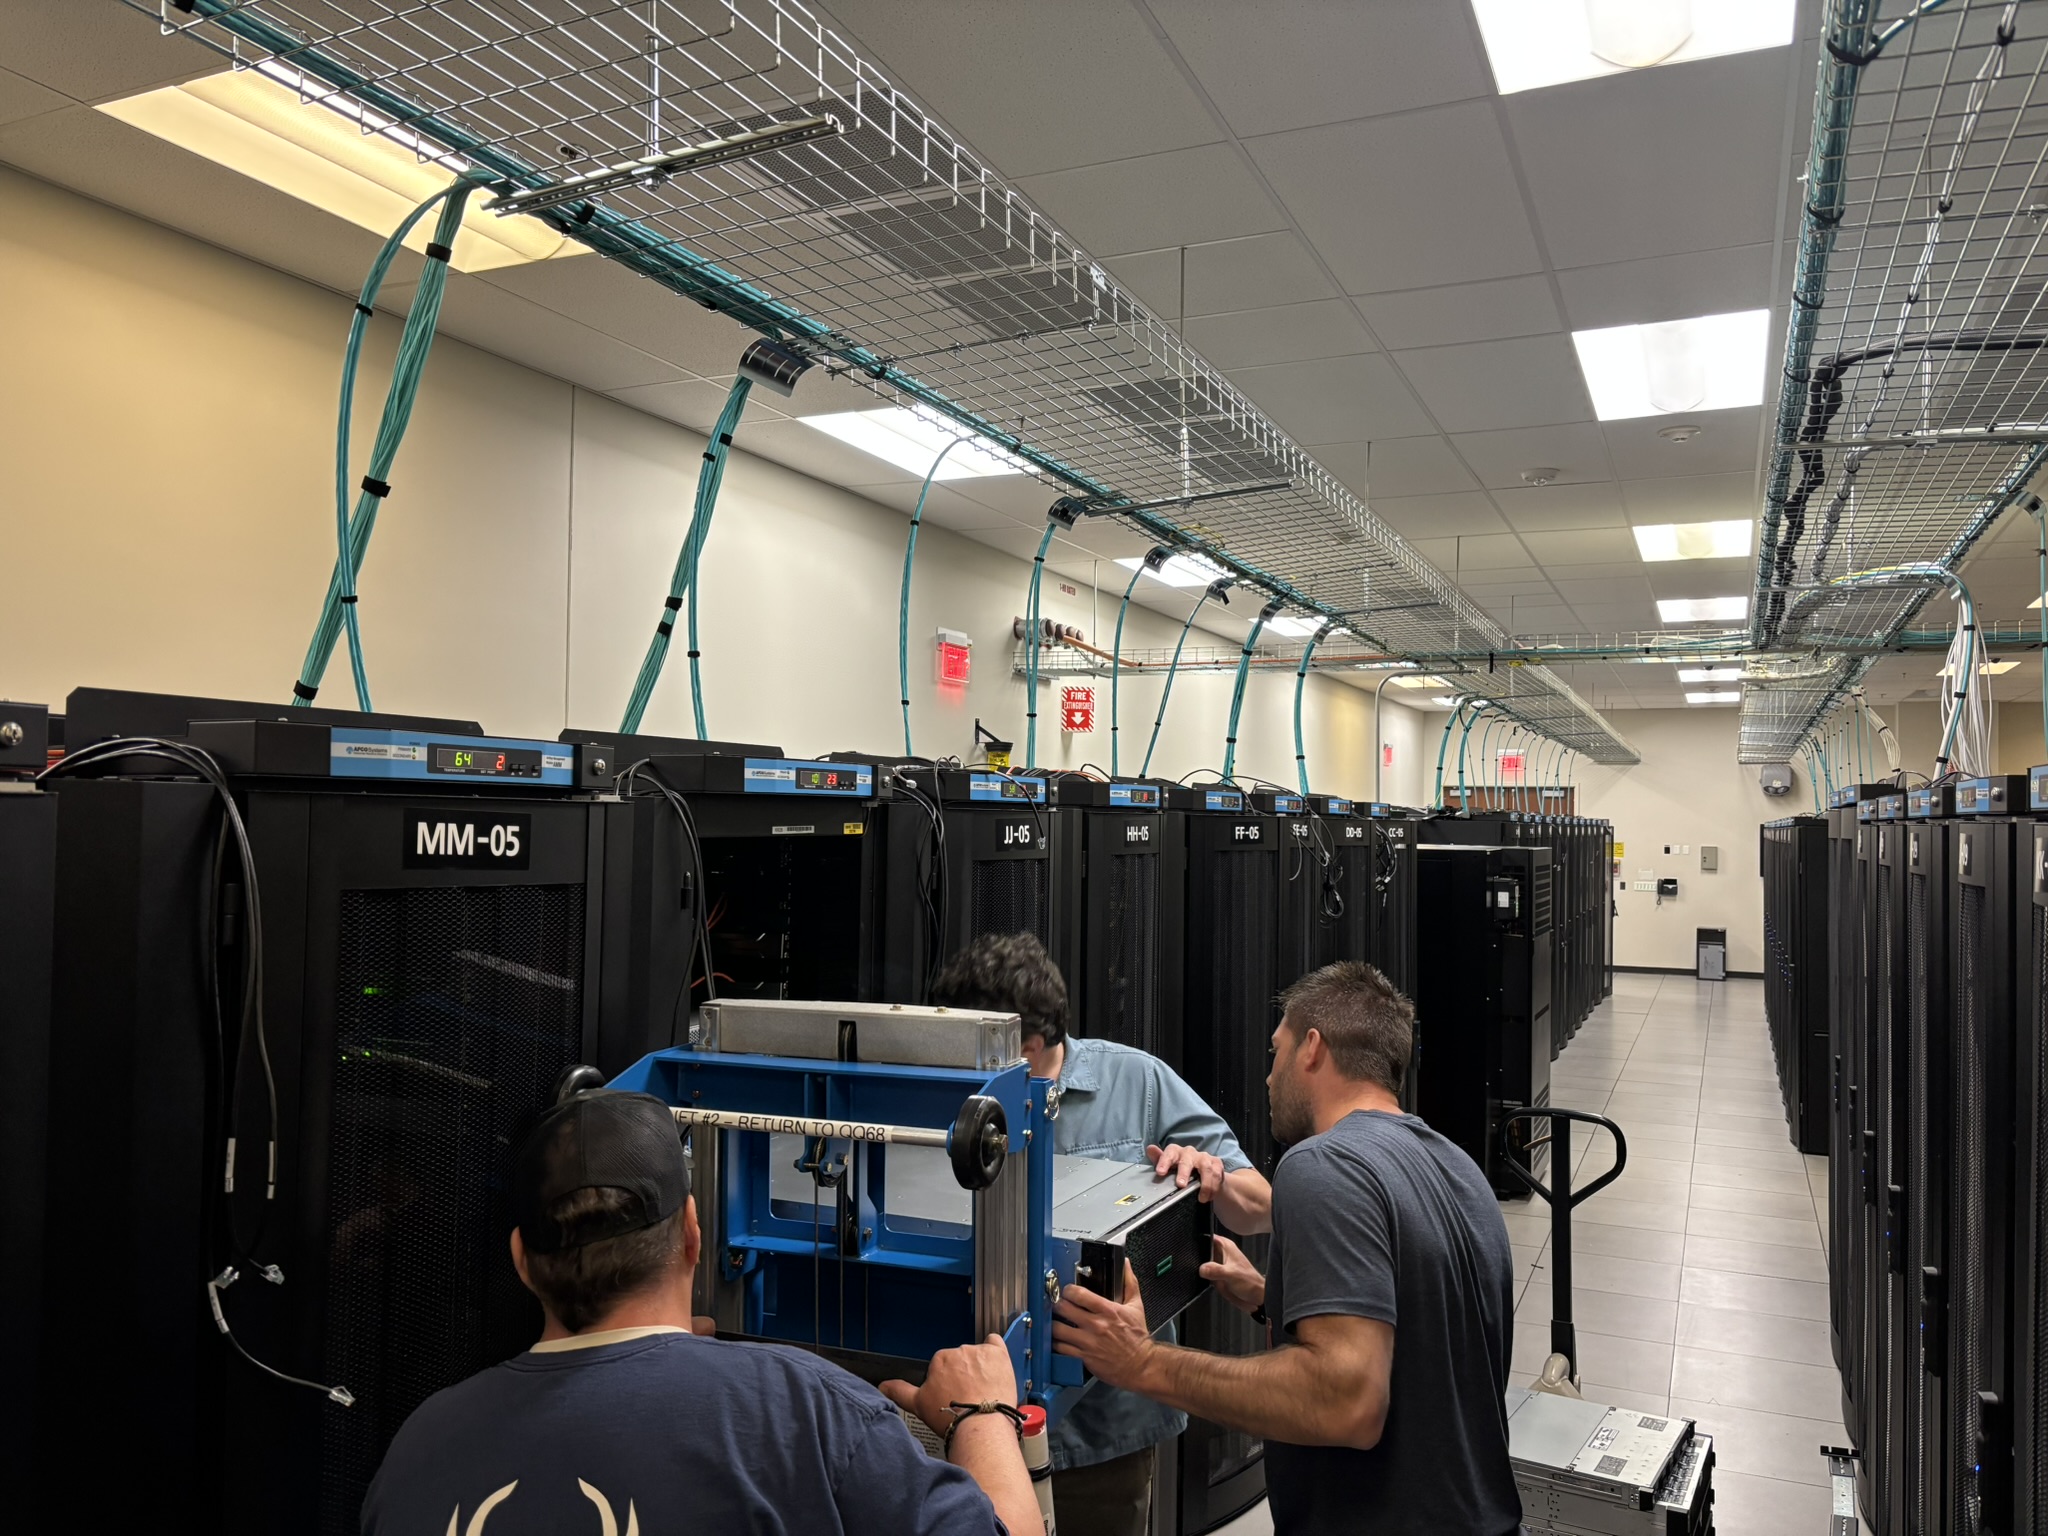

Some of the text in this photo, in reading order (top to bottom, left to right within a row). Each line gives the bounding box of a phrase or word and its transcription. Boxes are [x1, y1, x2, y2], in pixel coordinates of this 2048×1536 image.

[1070, 691, 1087, 701] FIRE
[1063, 701, 1094, 711] EXTINGUISHER
[455, 751, 471, 766] 64
[496, 755, 505, 769] 2
[416, 821, 520, 857] MM-05
[1003, 824, 1030, 844] JJ-05
[1126, 825, 1149, 842] HH-05
[1234, 826, 1260, 840] FF-05
[1345, 826, 1363, 838] DD-05
[1388, 827, 1404, 838] CC-05
[675, 1110, 699, 1125] IFT
[702, 1112, 720, 1127] #2
[738, 1115, 807, 1135] RETURN
[812, 1121, 834, 1137] TO
[839, 1124, 885, 1142] QQ68
